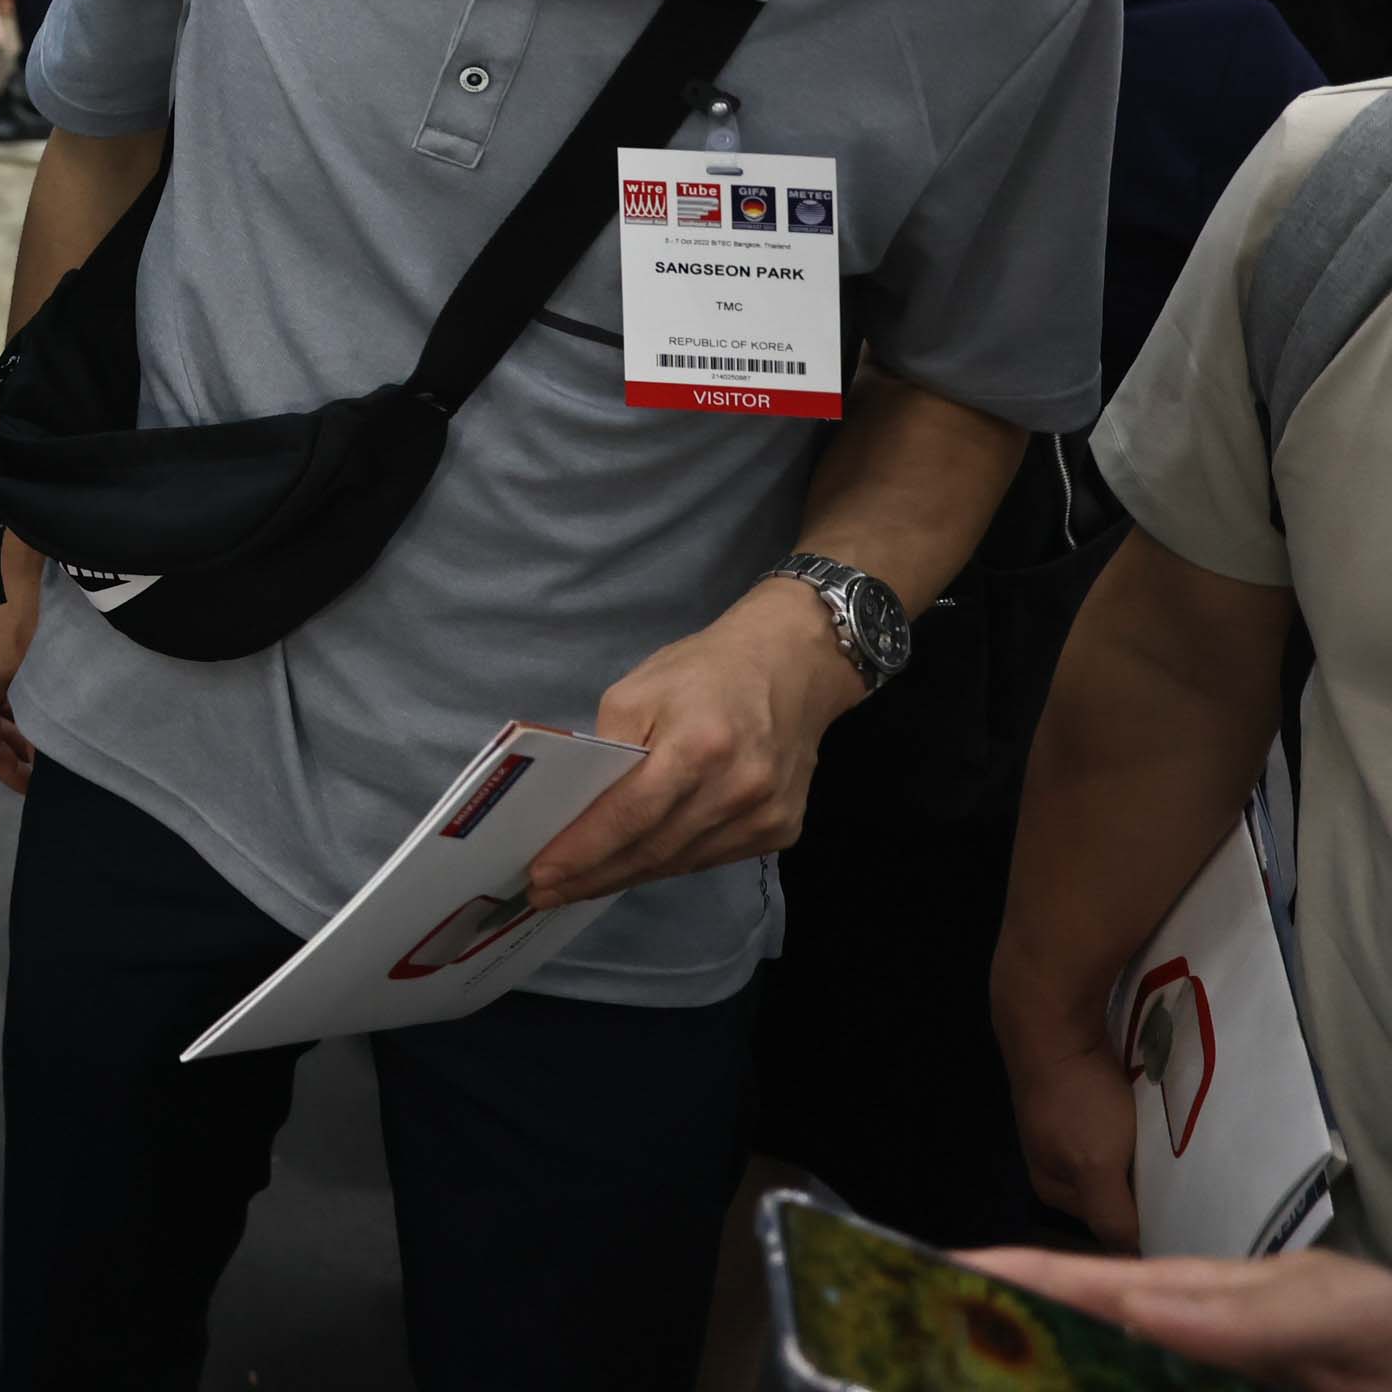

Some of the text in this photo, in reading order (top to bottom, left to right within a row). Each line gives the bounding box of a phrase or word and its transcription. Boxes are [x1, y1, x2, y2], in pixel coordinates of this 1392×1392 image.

[626, 181, 664, 194] wire
[680, 183, 718, 196] Tube
[738, 186, 768, 197] GIFA
[788, 190, 833, 200] METEC
[655, 261, 805, 281] SANGSEON PARK
[716, 301, 743, 312] TMC
[668, 336, 794, 353] REPUBLIC OF KOREA
[693, 390, 771, 409] VISITOR
